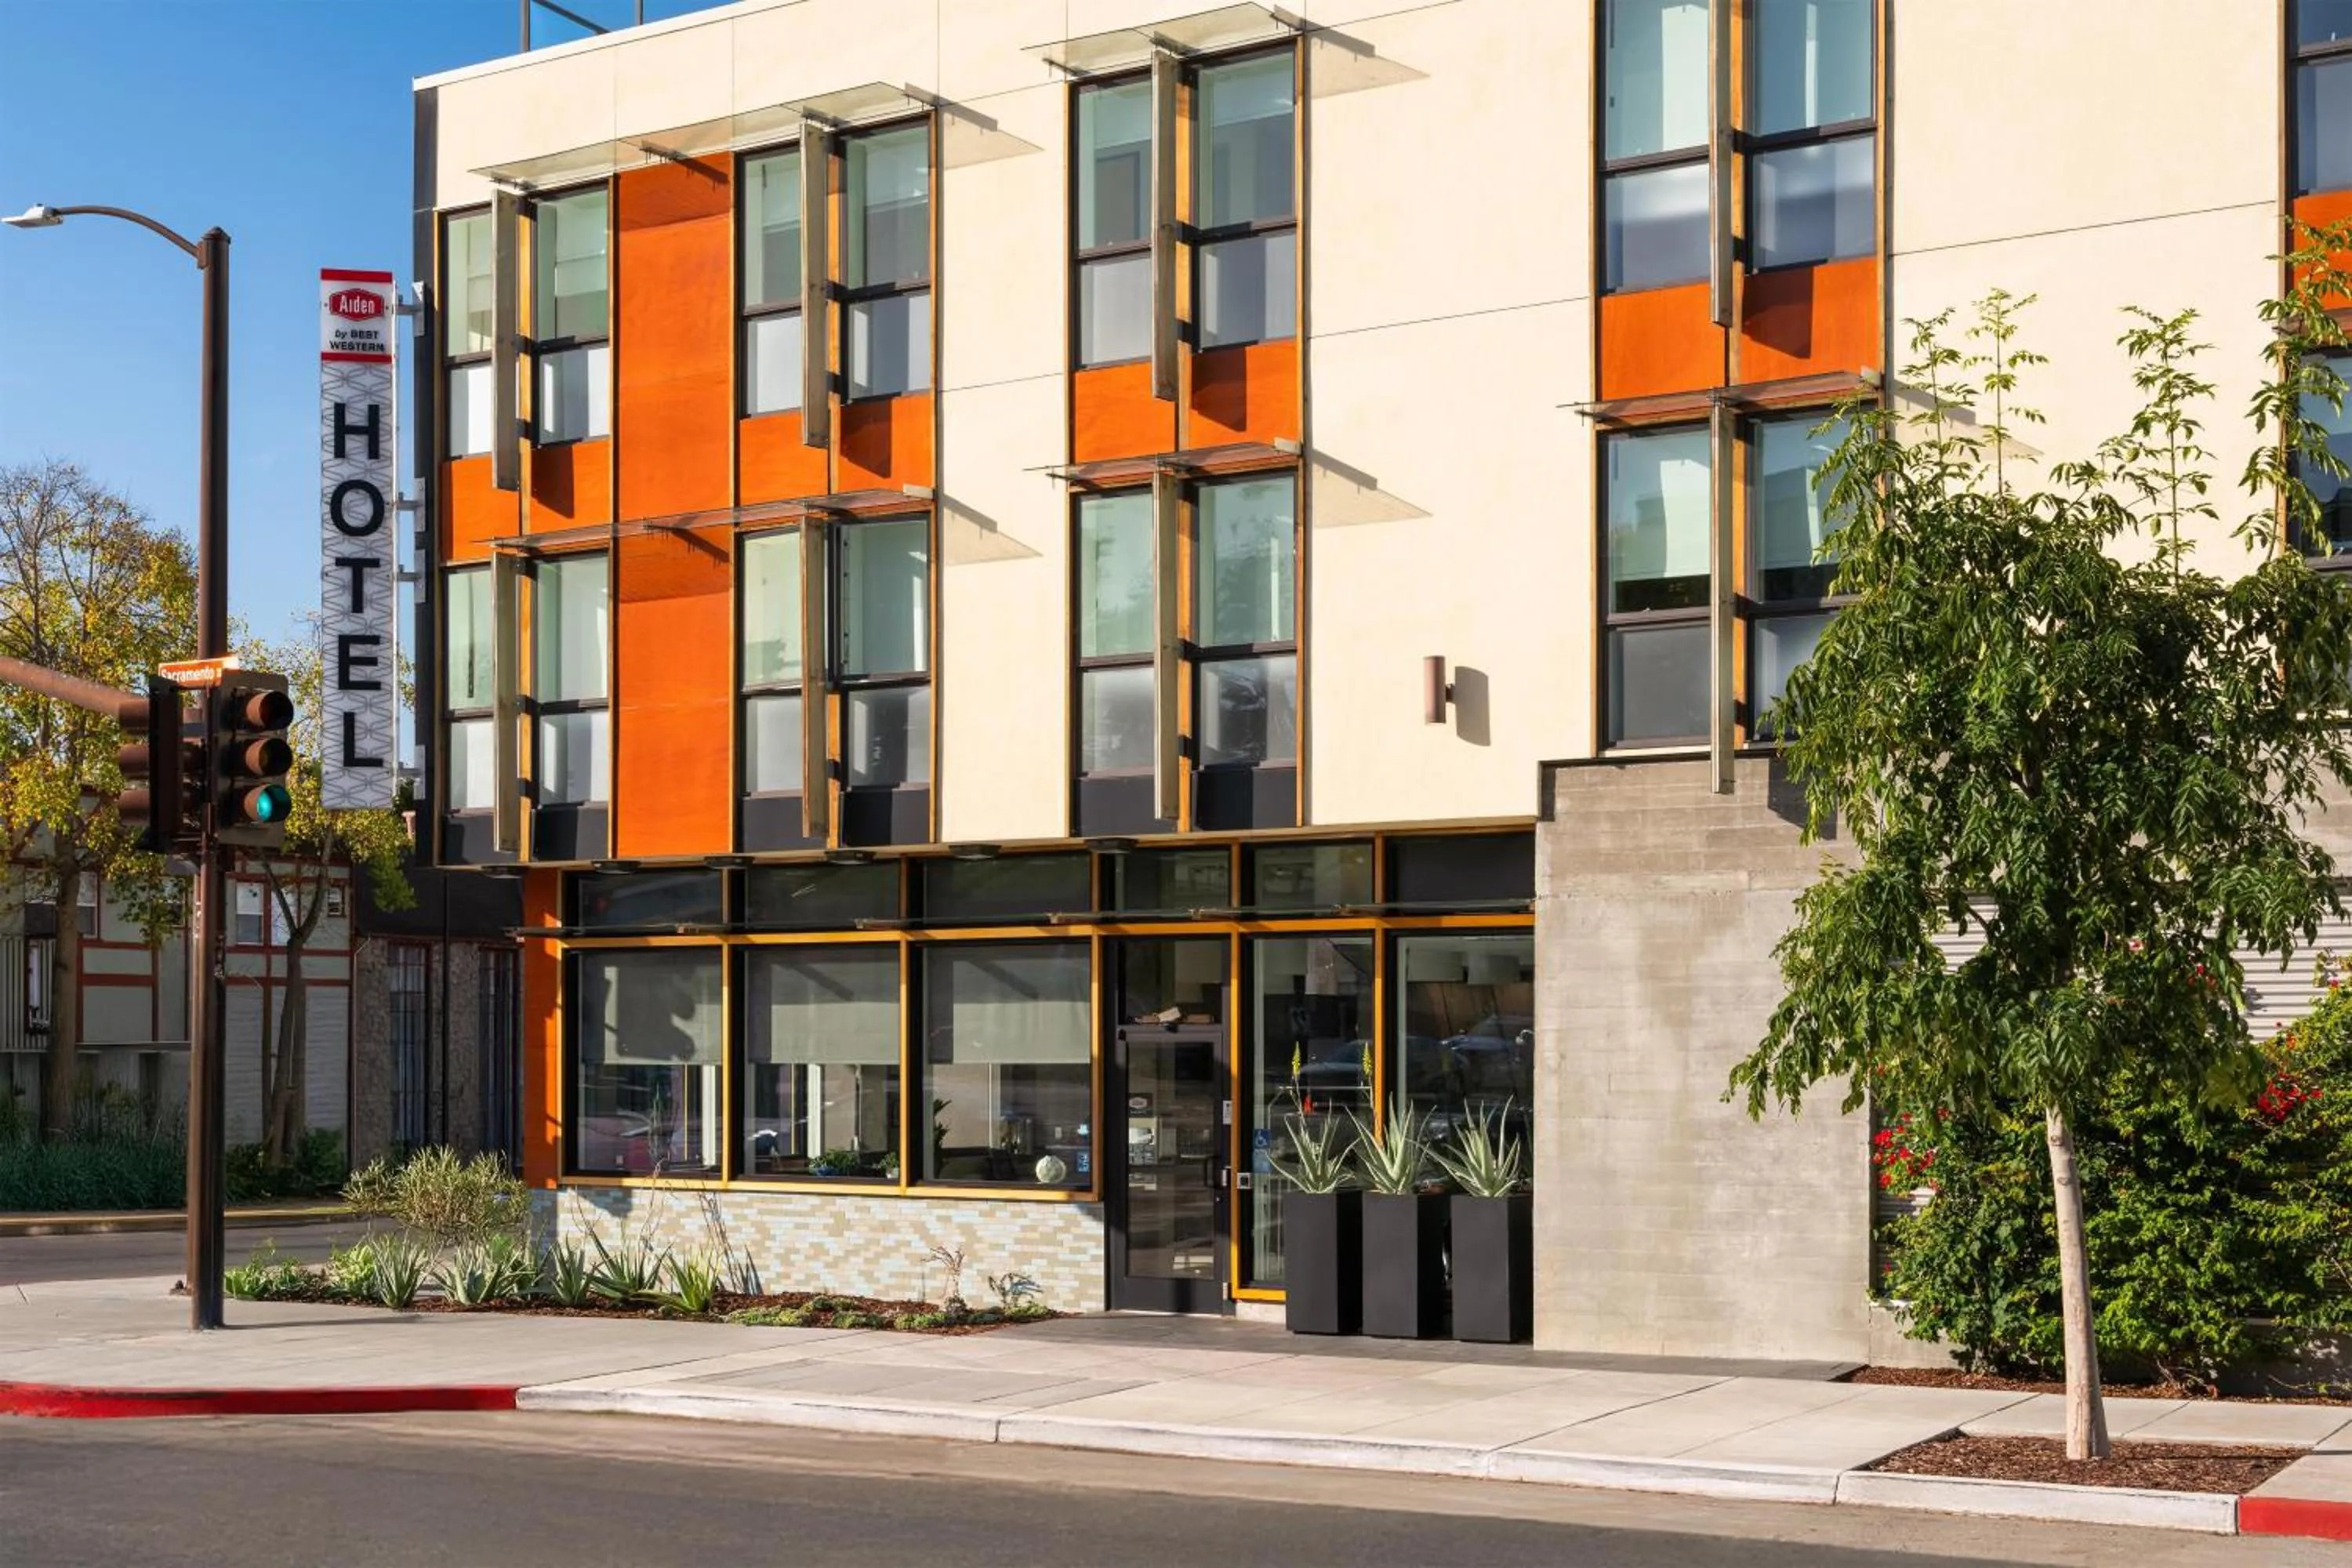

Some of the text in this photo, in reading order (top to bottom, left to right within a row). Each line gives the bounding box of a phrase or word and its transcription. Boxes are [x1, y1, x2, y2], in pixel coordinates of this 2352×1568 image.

[339, 295, 375, 314] Aiden
[335, 329, 379, 339] by BEST
[329, 341, 385, 351] WESTERN
[330, 402, 384, 768] HOTEL
